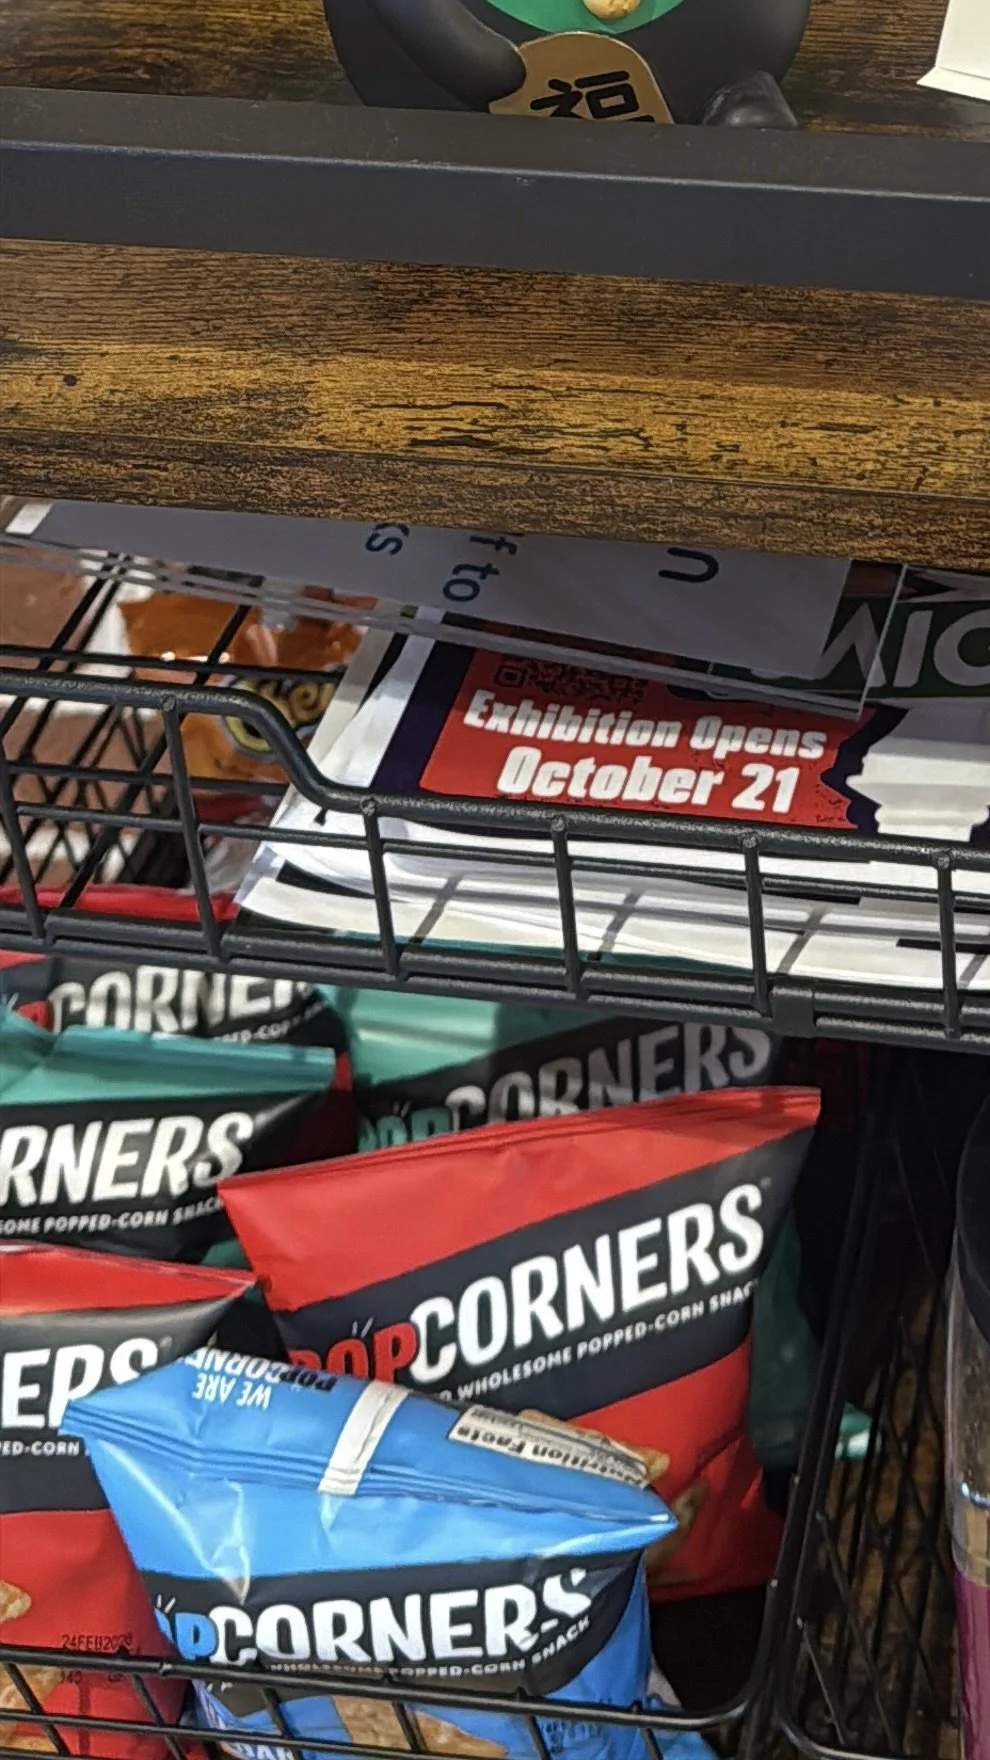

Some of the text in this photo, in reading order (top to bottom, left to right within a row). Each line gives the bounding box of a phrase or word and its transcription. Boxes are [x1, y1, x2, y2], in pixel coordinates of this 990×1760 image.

[443, 562, 499, 603] to
[463, 688, 828, 760] Exhibition Opens
[497, 745, 800, 814] October 21
[43, 1208, 168, 1234] POPPED-CORN
[172, 1195, 225, 1226] SNAC
[457, 1278, 758, 1401] WHOLESOME POPPED-CORN SNAC
[192, 1373, 272, 1410] WE ARE
[457, 1425, 526, 1454] Facts
[532, 1616, 591, 1666] SNACK
